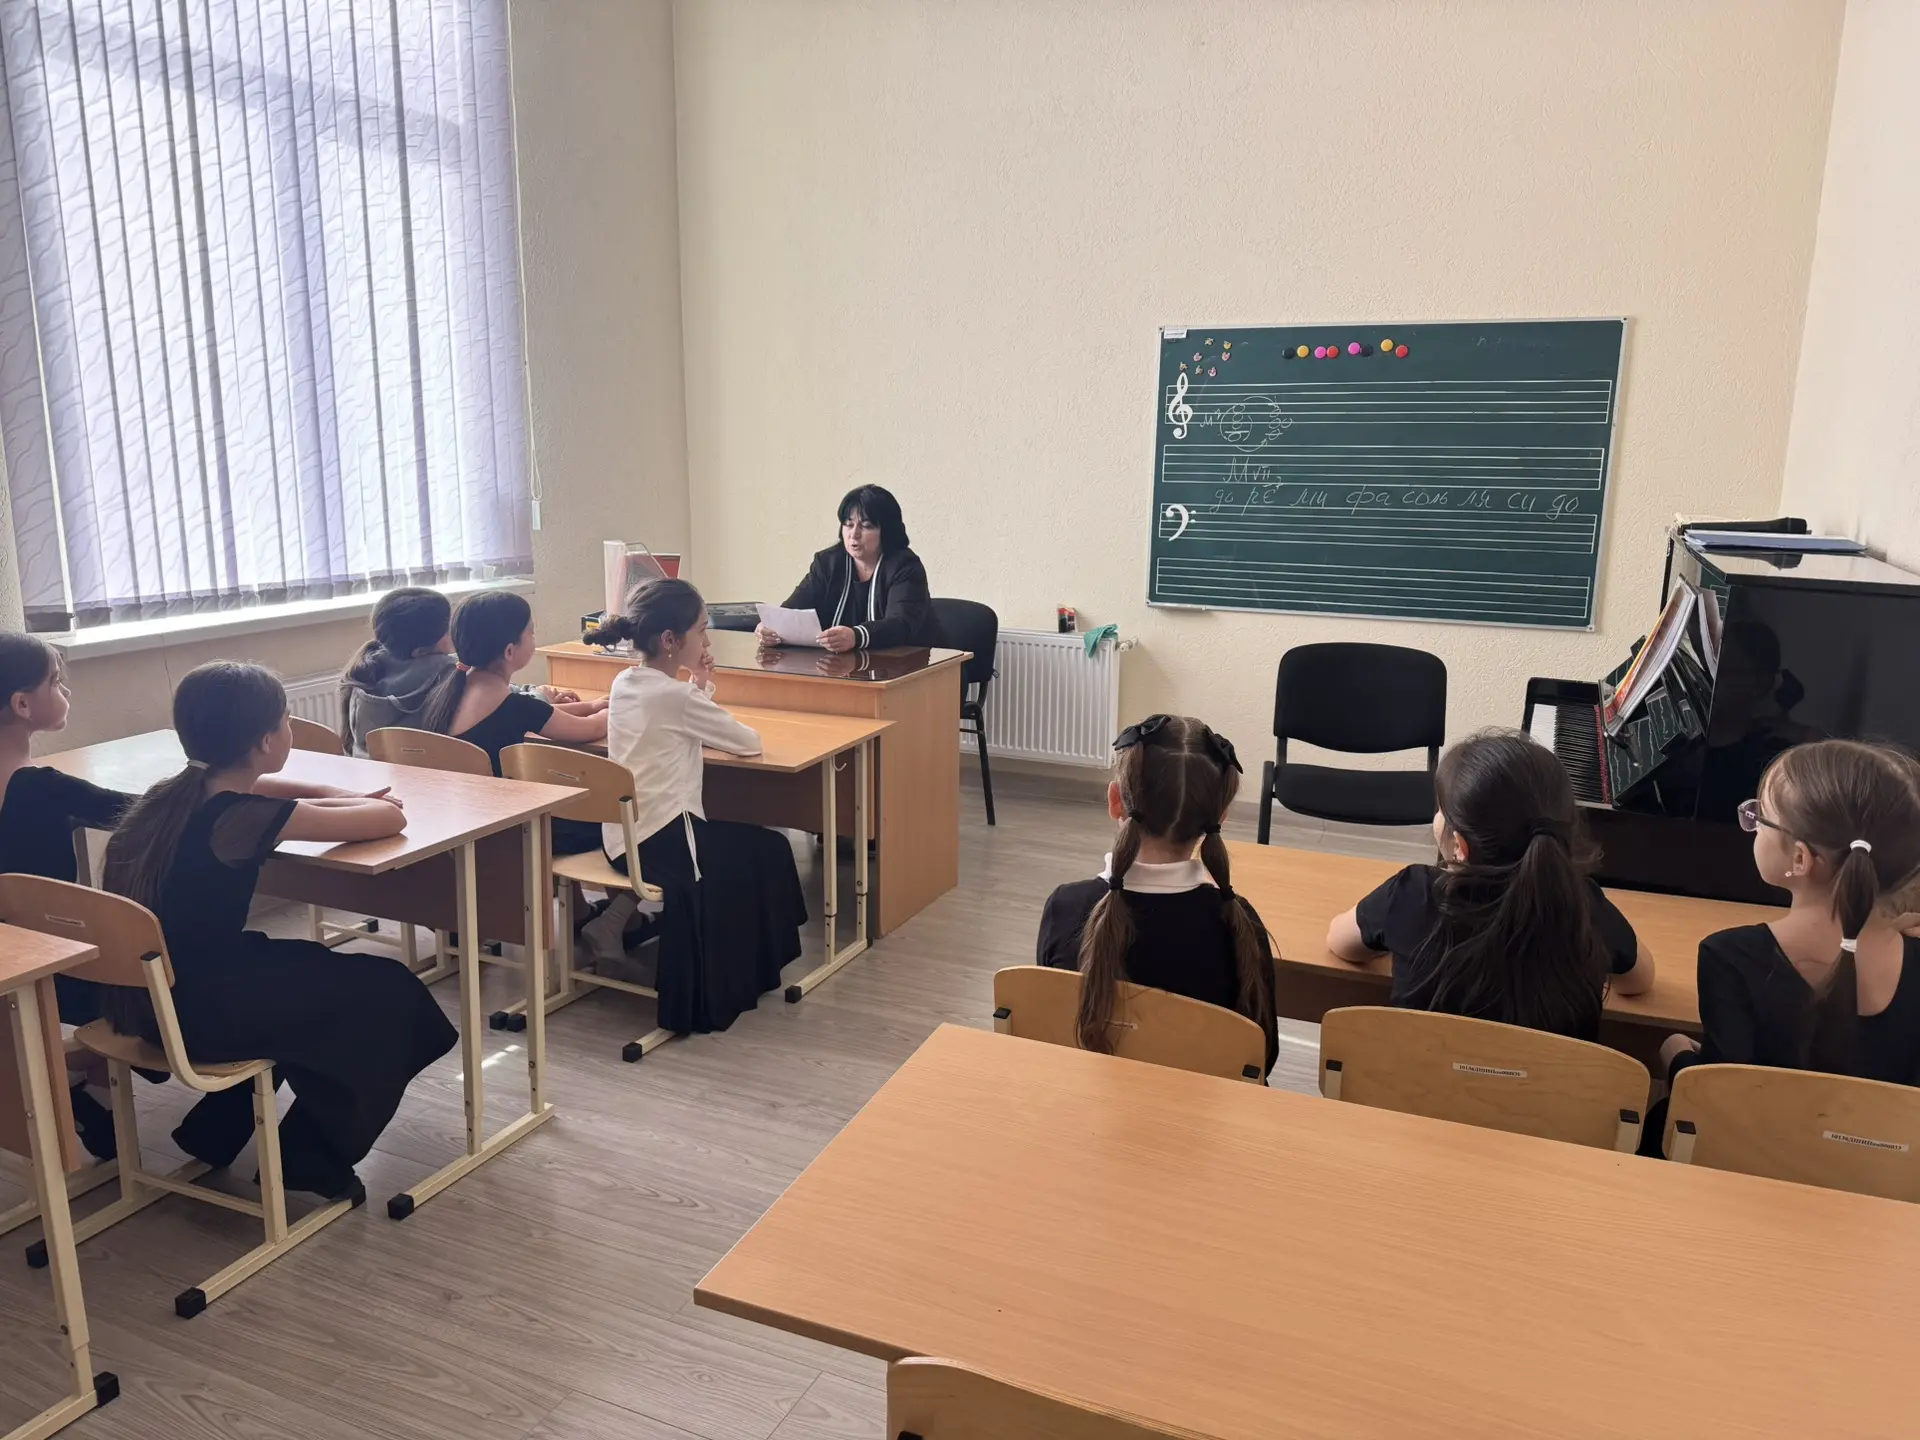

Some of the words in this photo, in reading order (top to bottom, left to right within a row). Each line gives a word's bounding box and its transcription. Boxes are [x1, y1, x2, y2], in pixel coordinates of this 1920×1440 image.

[1208, 489, 1234, 515] до
[1240, 486, 1277, 517] ре
[1289, 488, 1328, 509] ми
[1345, 484, 1393, 516] фа
[1402, 490, 1449, 506] соль
[1457, 489, 1493, 509] ля
[1507, 492, 1537, 512] си
[1545, 493, 1579, 521] до
